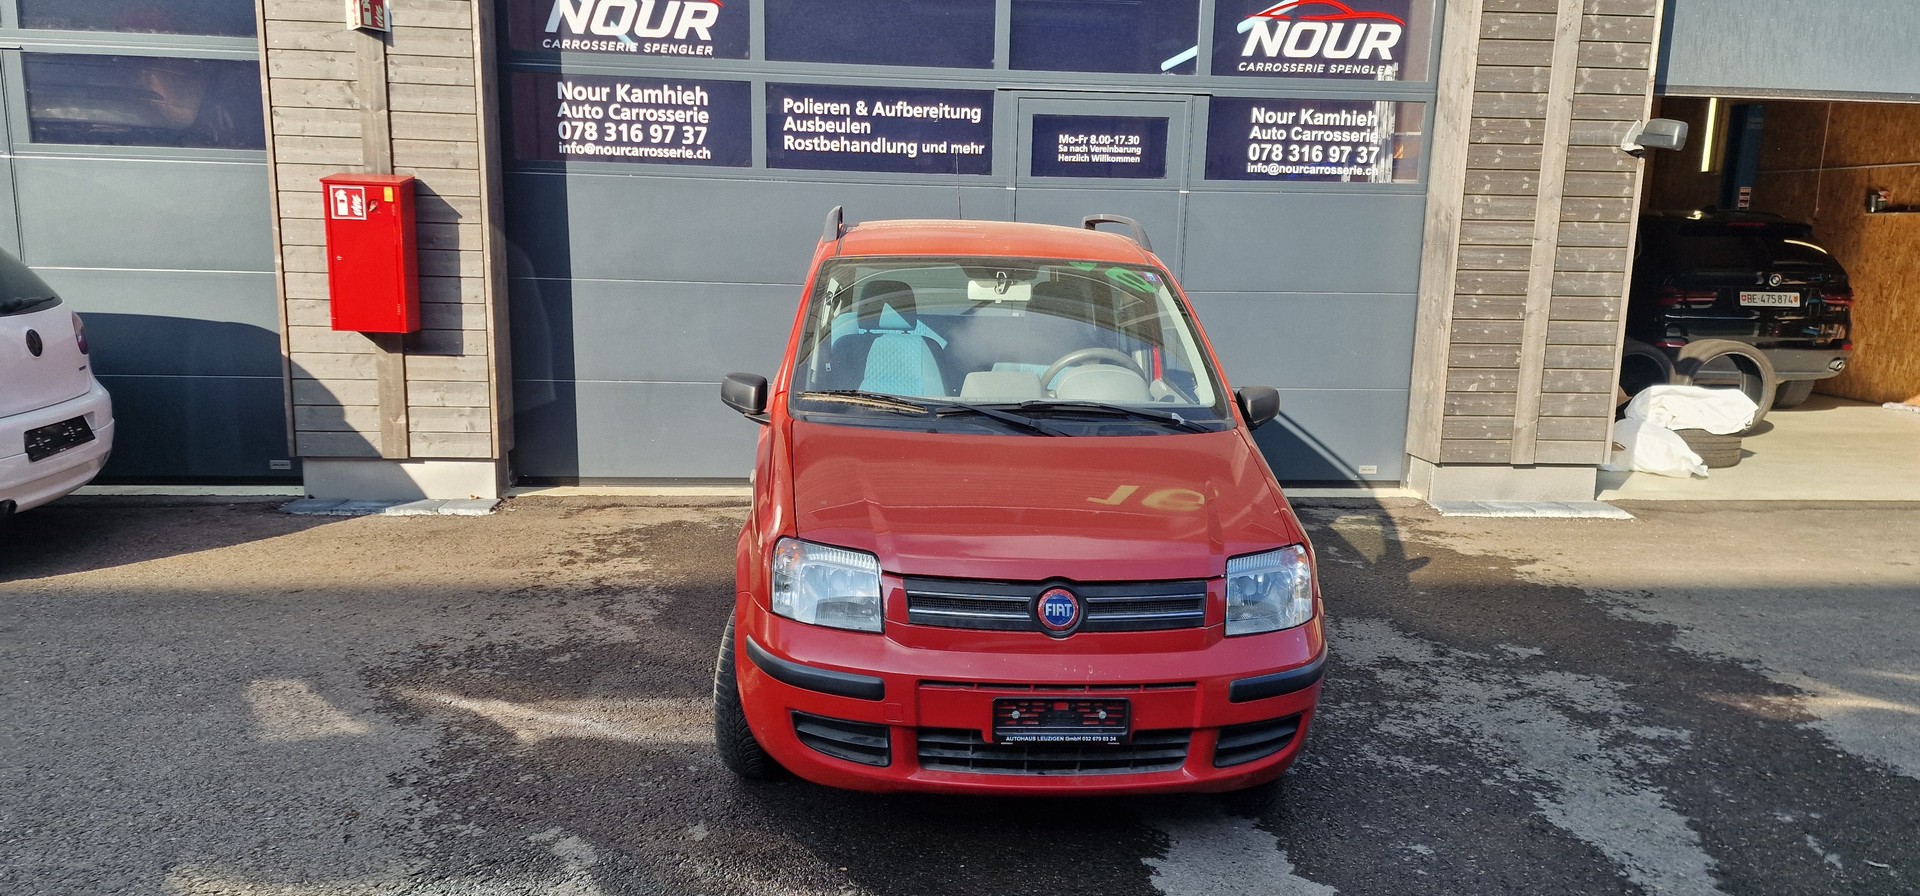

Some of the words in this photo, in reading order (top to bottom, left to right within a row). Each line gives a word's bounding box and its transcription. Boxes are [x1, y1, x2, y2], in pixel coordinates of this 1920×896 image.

[544, 0, 719, 41] NOUR
[542, 38, 639, 53] CARROSSERIE
[643, 42, 714, 56] SPENGLER
[1241, 20, 1402, 61] NOUR
[1238, 62, 1325, 73] CARROSSERIE
[1329, 64, 1396, 76] SPENGLER
[557, 81, 611, 101] Nour
[615, 83, 709, 107] Kamhieh
[557, 101, 604, 120] Auto
[608, 103, 710, 124] Carrosserie
[783, 97, 850, 116] Polieren
[855, 100, 868, 116] &
[872, 101, 982, 124] Aufbereitung
[1251, 107, 1296, 125] Nour
[1301, 108, 1378, 127] Kamhieh
[558, 120, 598, 141] 078
[604, 123, 643, 143] 316
[649, 125, 676, 144] 97
[682, 125, 708, 146] 37
[783, 116, 872, 135] Ausbeulen
[1248, 125, 1287, 141] Auto
[1291, 126, 1379, 144] Carrosserie
[783, 135, 918, 158] Rostbehandlung
[921, 141, 947, 154] und
[950, 142, 985, 155] mehr
[1058, 134, 1089, 145] Mo-Fr
[1089, 134, 1140, 146] 8.00-17.30
[558, 141, 712, 160] info@nourcarrosserie.ch
[1057, 144, 1068, 153] Sa
[1069, 144, 1089, 154] nach
[1089, 144, 1142, 156] Vereinbarung
[1057, 154, 1090, 163] Herzlich
[1091, 154, 1141, 164] Willkommen
[1248, 143, 1283, 161] 078
[1288, 144, 1323, 162] 316
[1329, 145, 1352, 163] 97
[1356, 146, 1380, 164] 37
[1247, 162, 1379, 177] info@nourcarrosserie.ch
[1045, 602, 1073, 617] FIAT
